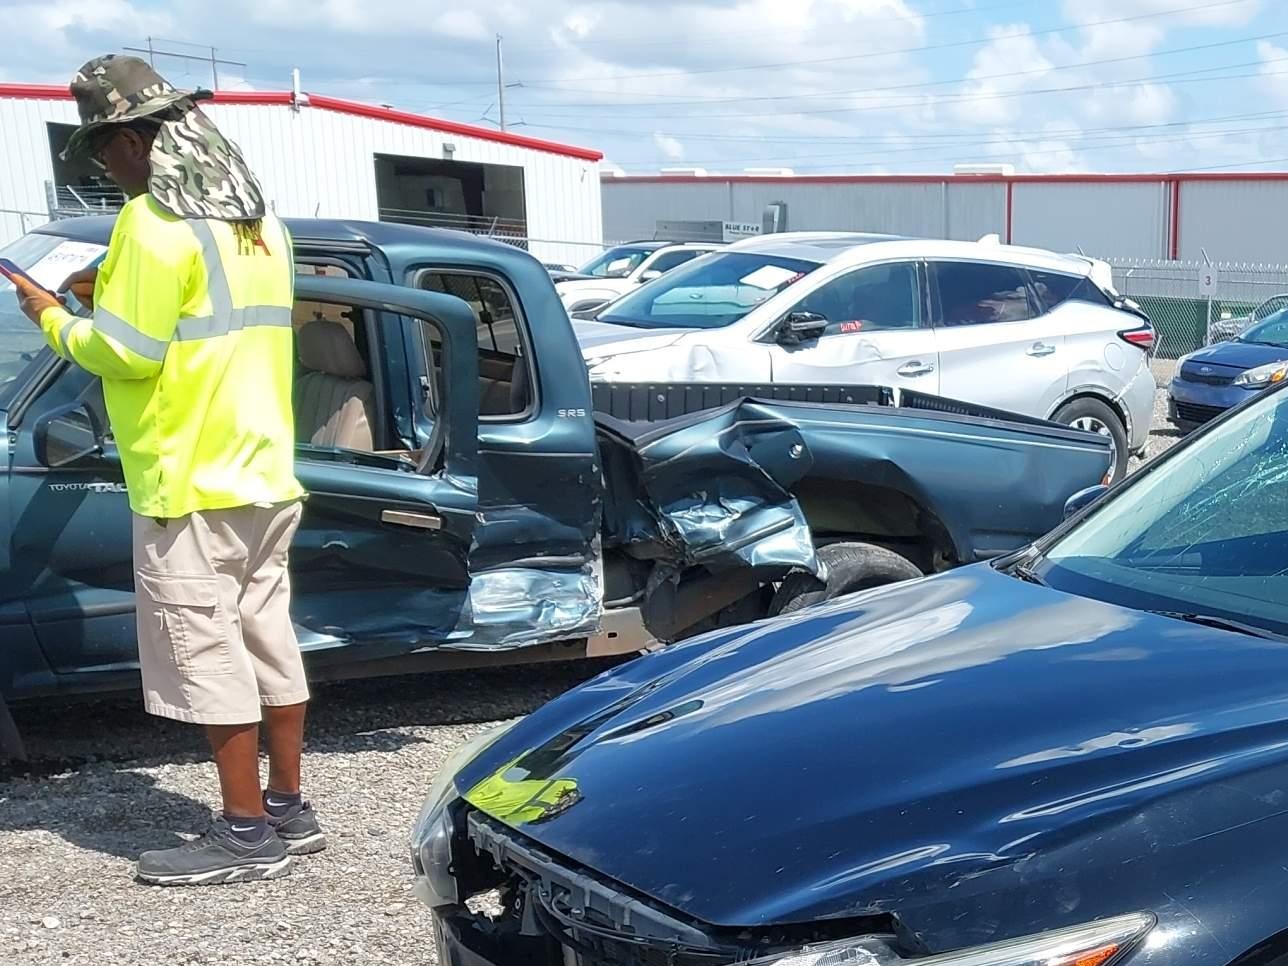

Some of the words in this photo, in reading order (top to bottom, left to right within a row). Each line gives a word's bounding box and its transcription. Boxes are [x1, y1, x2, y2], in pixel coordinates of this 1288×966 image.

[1205, 275, 1211, 286] 3
[557, 408, 586, 418] SRS
[48, 482, 91, 492] TOYOTA
